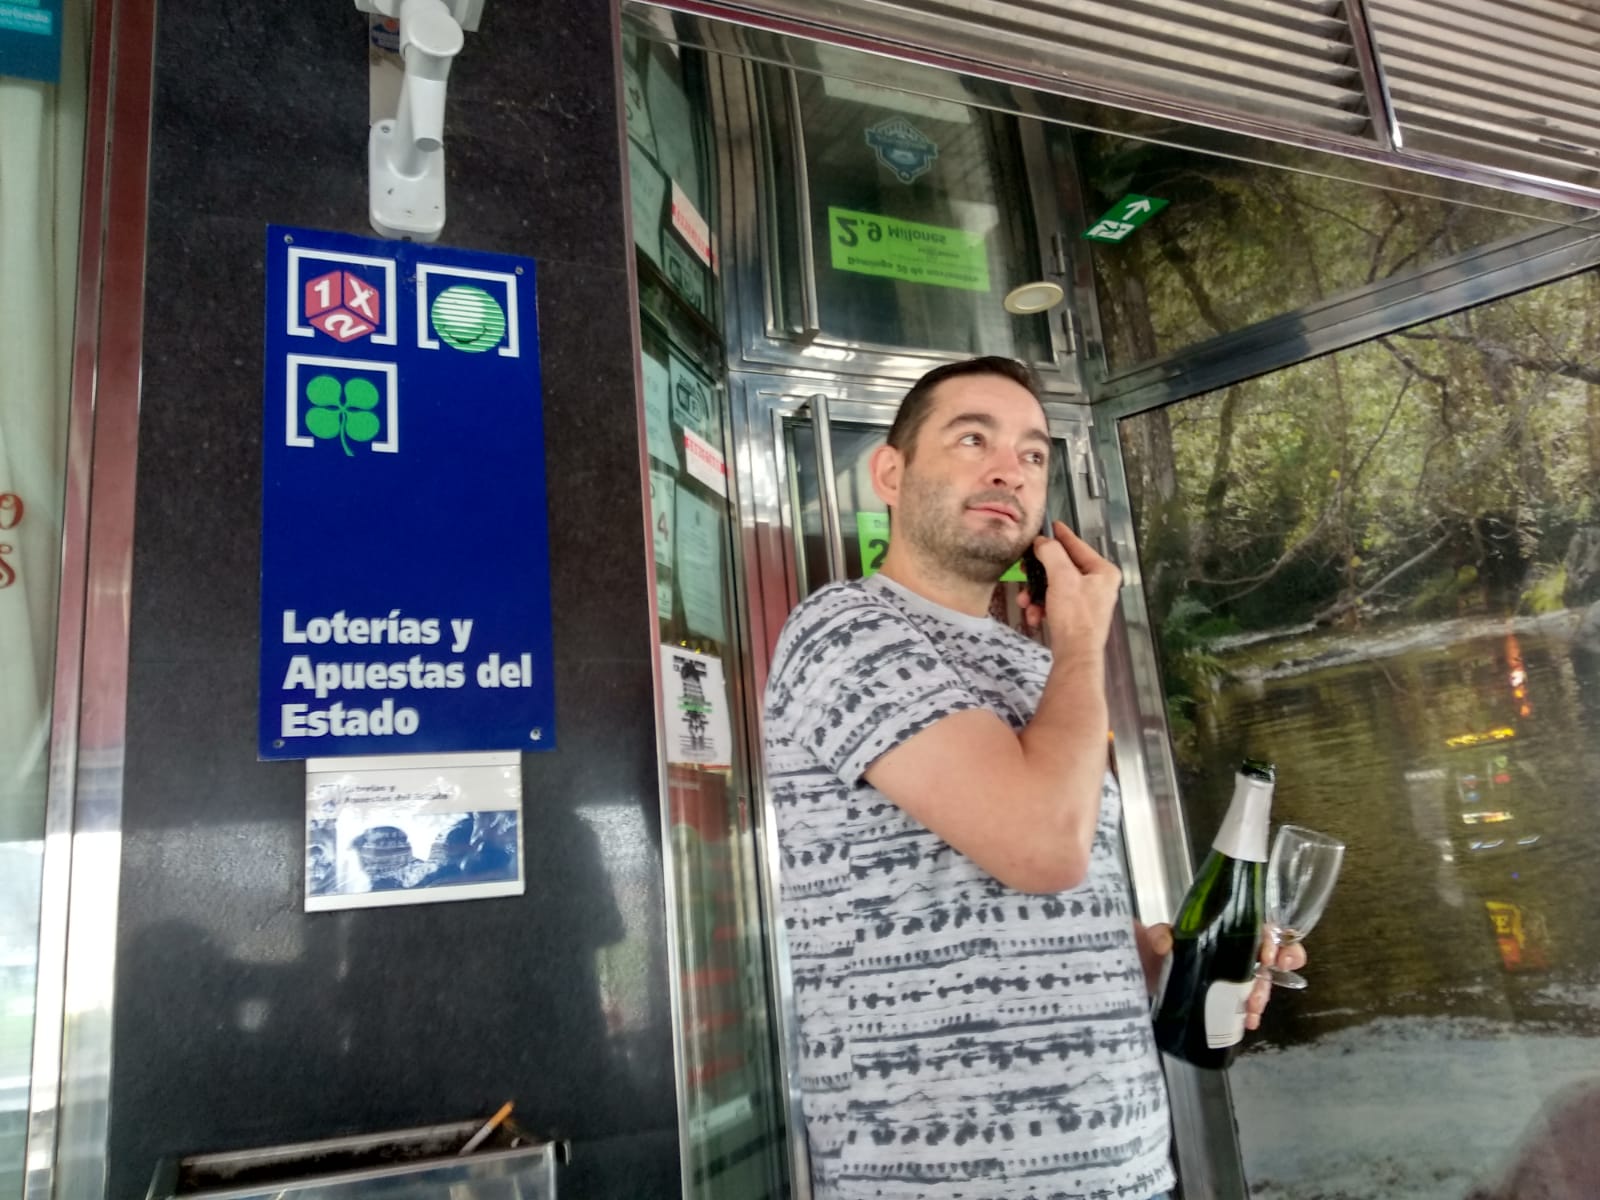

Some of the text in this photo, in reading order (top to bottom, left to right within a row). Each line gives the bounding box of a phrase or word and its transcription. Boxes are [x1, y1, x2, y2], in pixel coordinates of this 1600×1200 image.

[283, 608, 473, 654] Loterías y
[282, 652, 533, 699] Apuestas del
[281, 697, 420, 738] Estado
